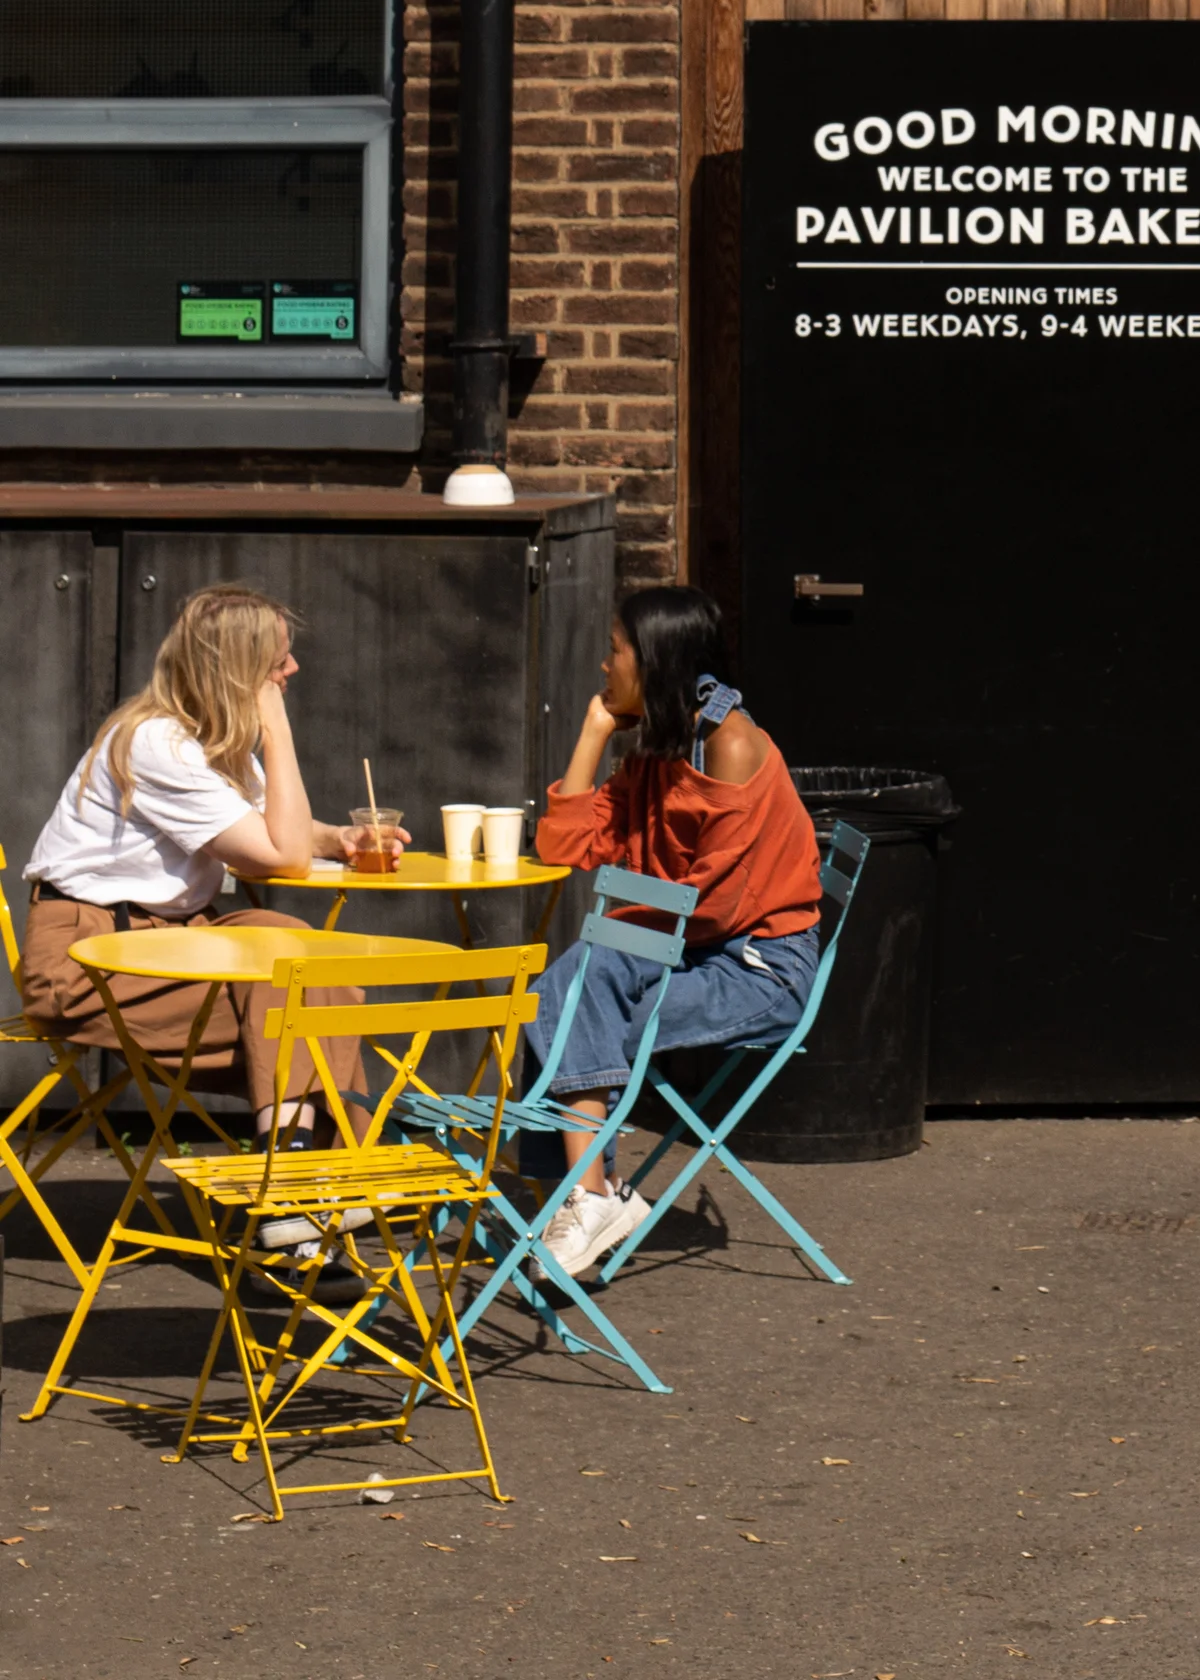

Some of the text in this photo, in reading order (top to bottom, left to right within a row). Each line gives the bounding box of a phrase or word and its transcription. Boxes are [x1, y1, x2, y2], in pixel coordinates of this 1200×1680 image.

[814, 109, 975, 161] GOOD
[878, 166, 1187, 192] WELCOME TO THE
[797, 207, 1043, 244] PAVILION
[946, 288, 1117, 304] OPENING TIMES
[796, 314, 841, 336] 8-3
[853, 315, 1026, 339] WEEKDAYS,
[1041, 315, 1087, 336] 9-4
